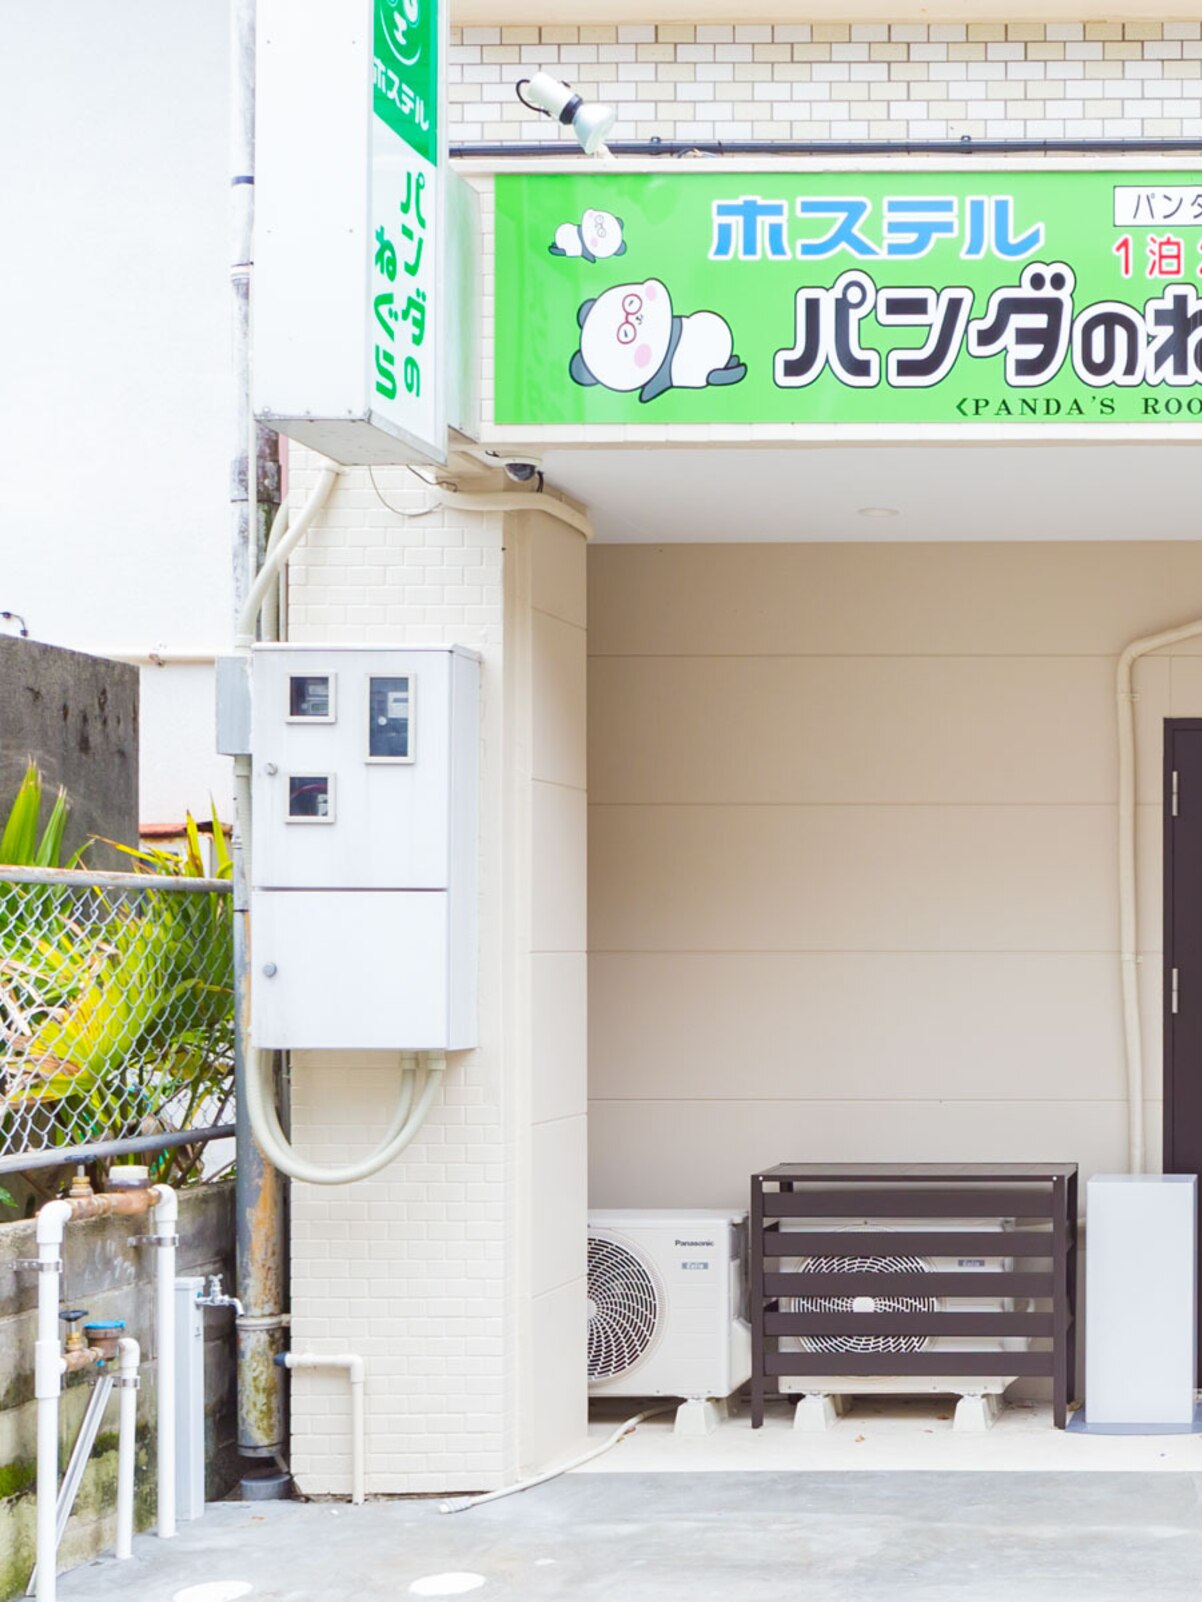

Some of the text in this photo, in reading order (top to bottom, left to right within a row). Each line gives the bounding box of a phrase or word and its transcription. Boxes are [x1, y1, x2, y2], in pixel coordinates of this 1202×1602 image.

[374, 56, 429, 131] ホステル
[710, 197, 1044, 259] ホステル
[374, 225, 398, 400] ねぐら
[400, 171, 427, 397] パンダの
[674, 1239, 715, 1247] Panasonic
